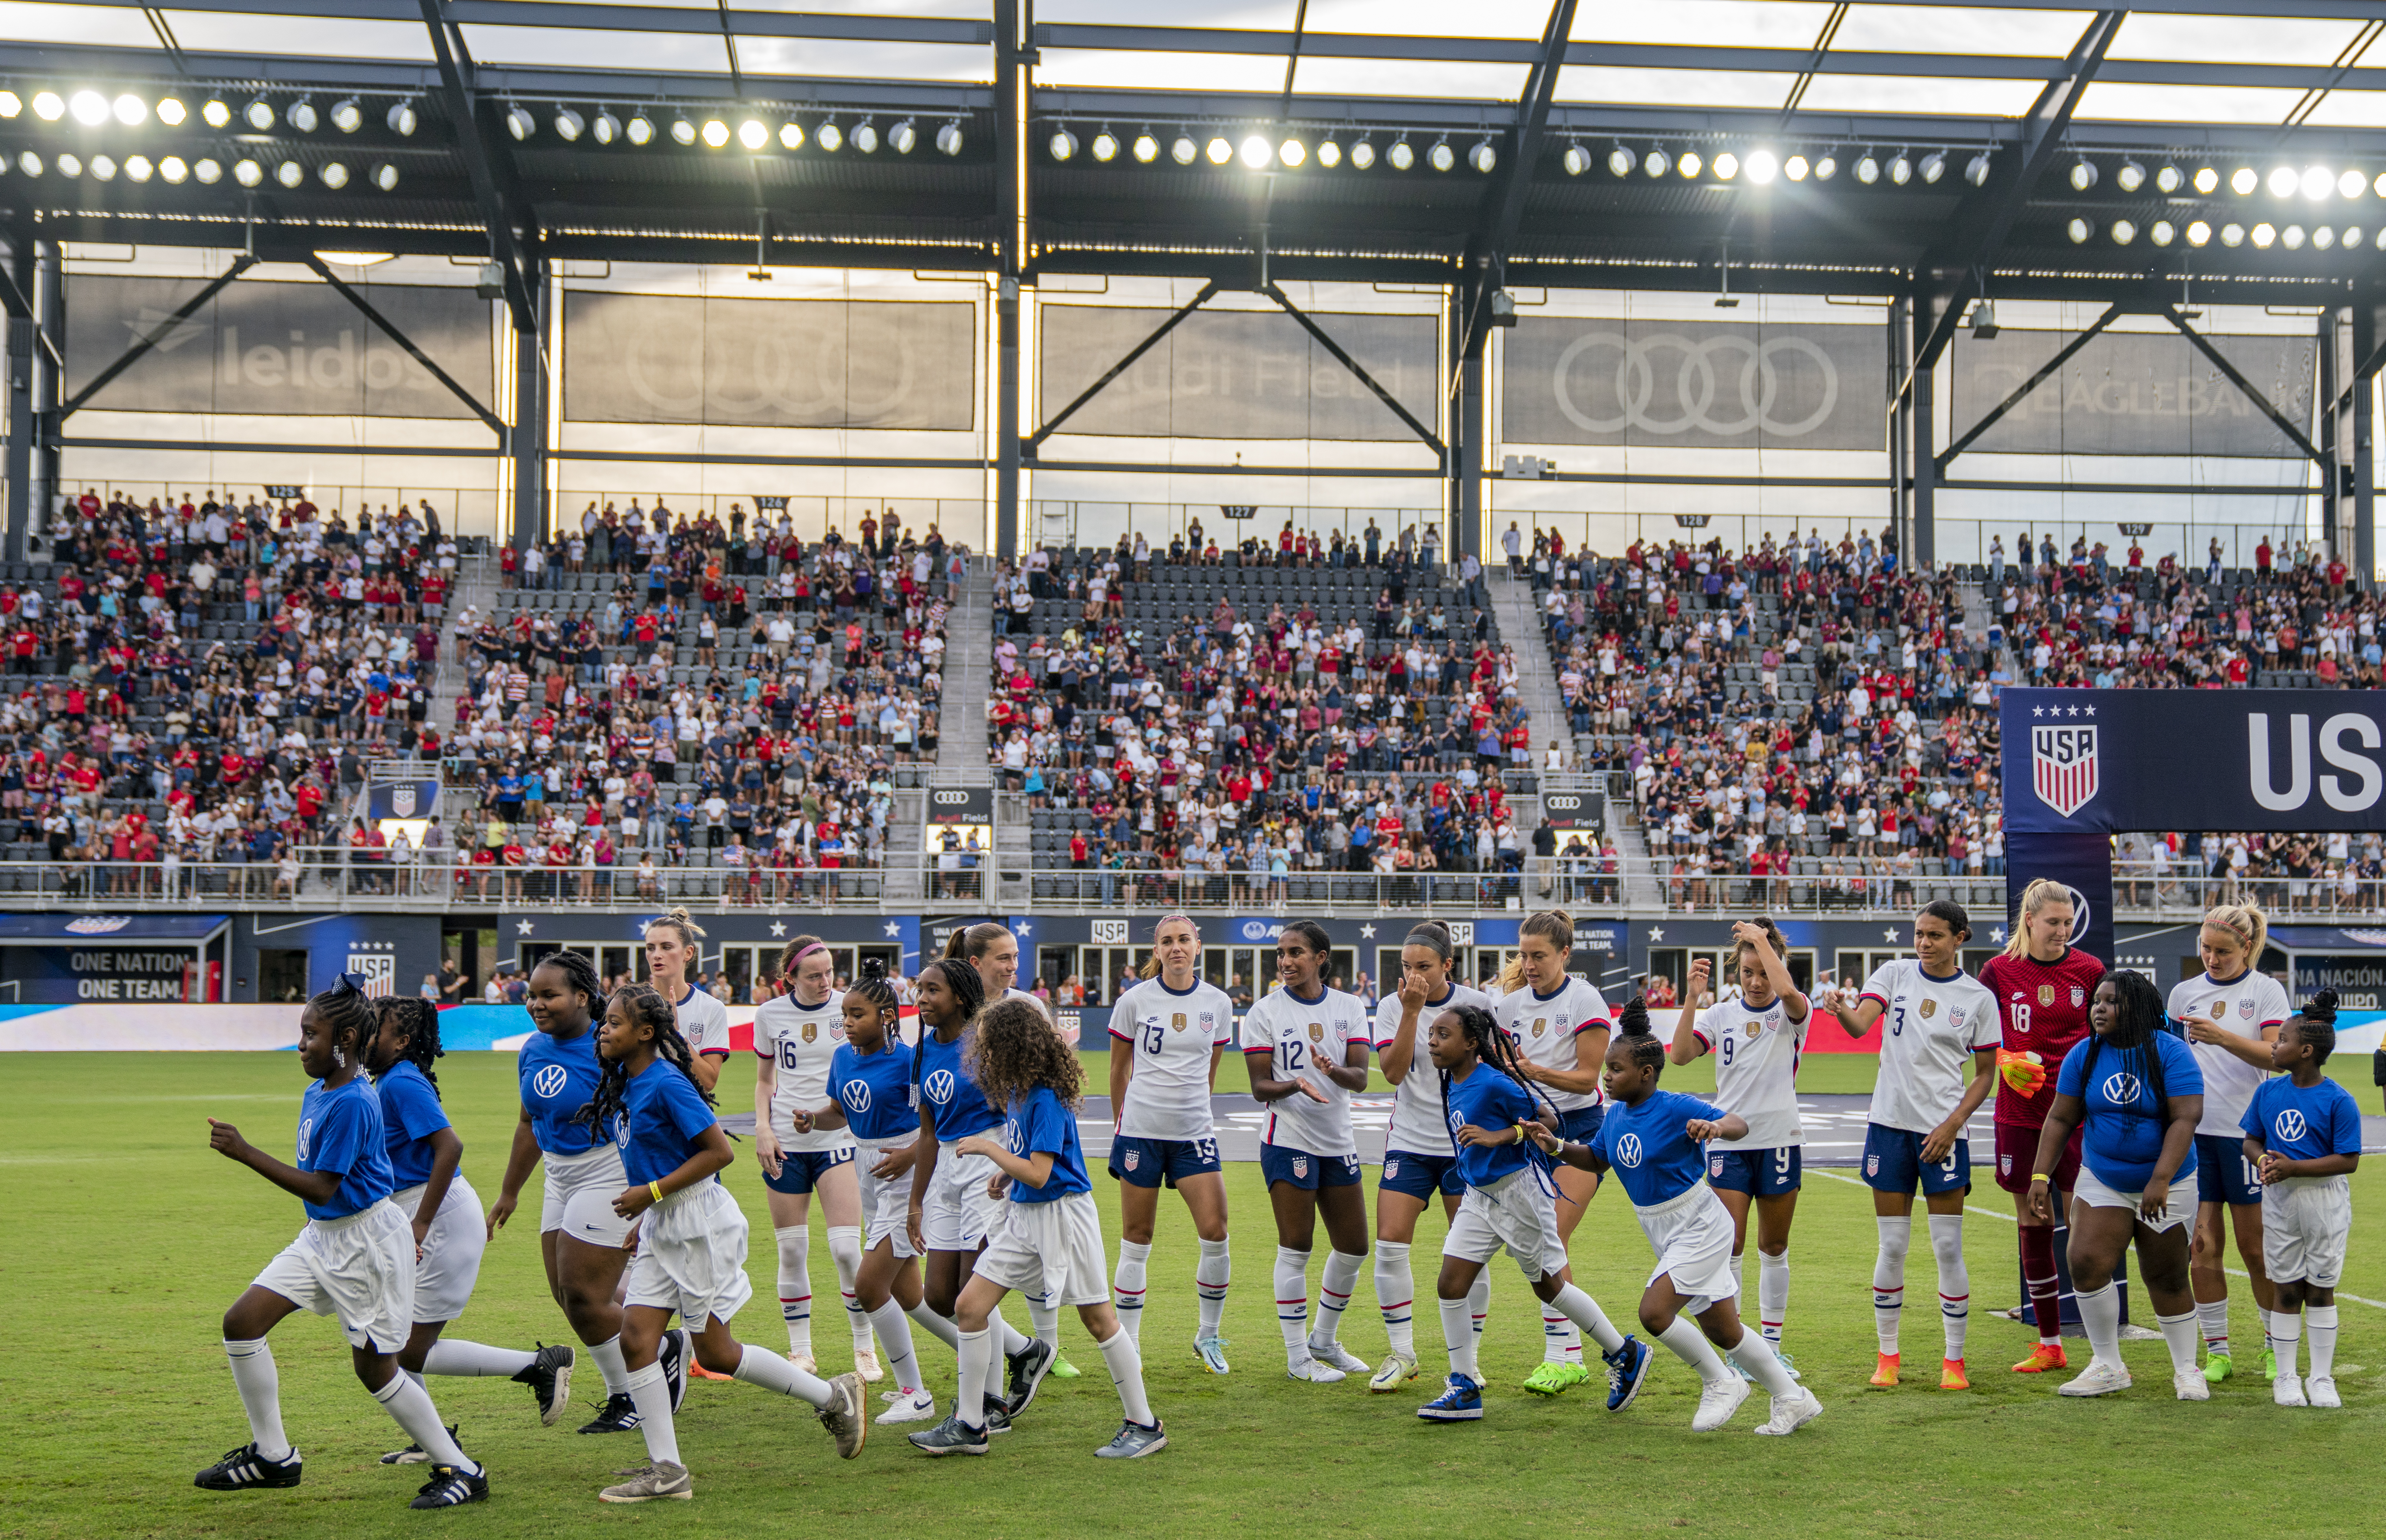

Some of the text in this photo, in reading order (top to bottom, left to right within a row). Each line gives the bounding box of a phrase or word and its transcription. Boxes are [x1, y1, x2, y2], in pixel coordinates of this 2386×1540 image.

[273, 486, 296, 497] 125
[761, 497, 779, 508] 126
[1229, 506, 1250, 517] 127
[1683, 516, 1703, 526] 128
[2127, 524, 2145, 534] 129
[2037, 730, 2093, 764] USA
[962, 814, 988, 822] Field
[1575, 819, 1599, 827] Field
[1095, 923, 1125, 940] USA
[1452, 925, 1470, 942] SA
[1585, 930, 1616, 939] NATION.
[1588, 941, 1613, 950] TEAM.
[71, 952, 112, 971] ONE
[352, 959, 390, 979] USA
[78, 979, 119, 999] ONE
[1893, 1007, 1905, 1036] 3
[1952, 1009, 1964, 1017] USA
[2010, 1003, 2031, 1032] 18
[1060, 1019, 1078, 1030] USA
[1144, 1025, 1165, 1055] 13
[778, 1041, 796, 1069] 16
[1280, 1040, 1304, 1071] 12
[1724, 1037, 1734, 1066] 9
[1776, 1147, 1789, 1173] 9
[1868, 1159, 1878, 1167] USA
[1941, 1141, 1956, 1171] 3
